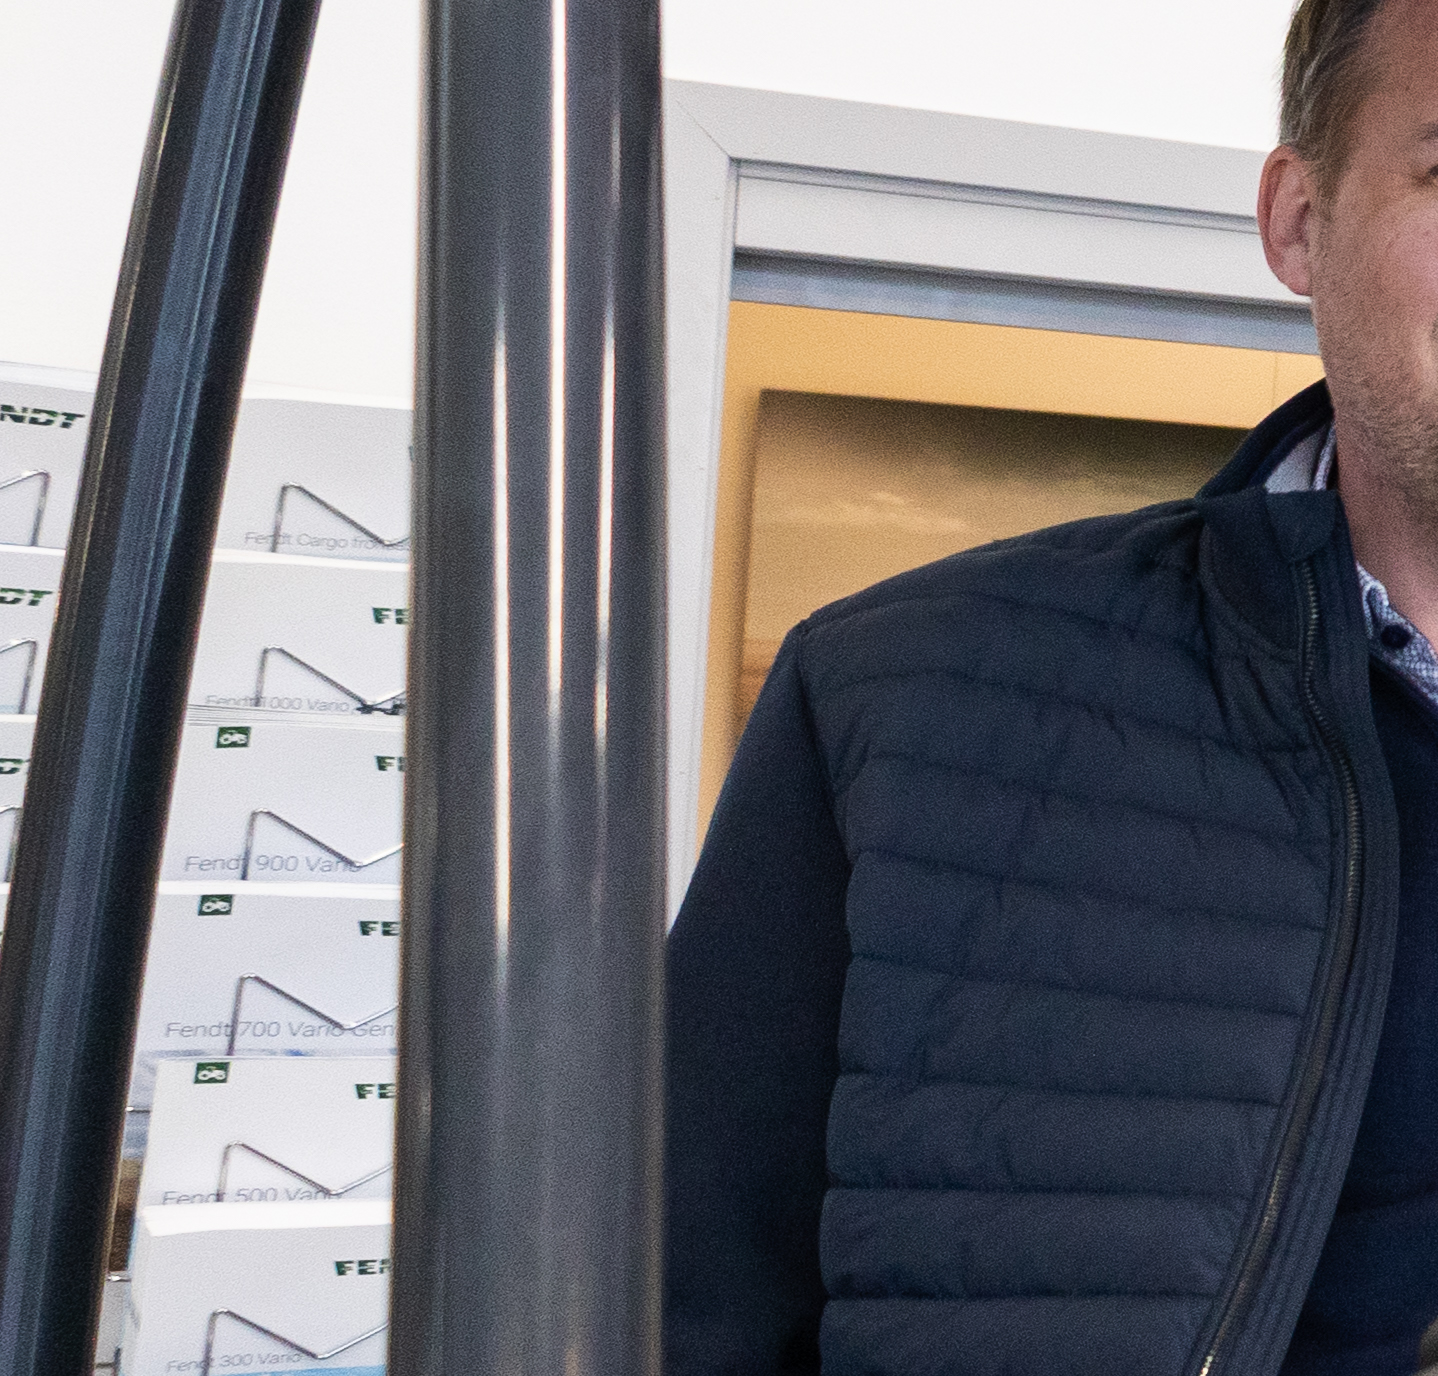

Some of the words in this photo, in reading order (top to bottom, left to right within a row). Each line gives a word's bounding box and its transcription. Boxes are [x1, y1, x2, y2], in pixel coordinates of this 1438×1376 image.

[297, 532, 349, 551] Cargo
[305, 697, 350, 712] Vario
[254, 854, 299, 872] 900
[304, 854, 362, 873] Vario
[238, 1021, 282, 1039] 700
[286, 1021, 344, 1038] Vario
[236, 1187, 279, 1203] 500
[219, 1353, 256, 1370] 300
[257, 1352, 302, 1369] Vario
